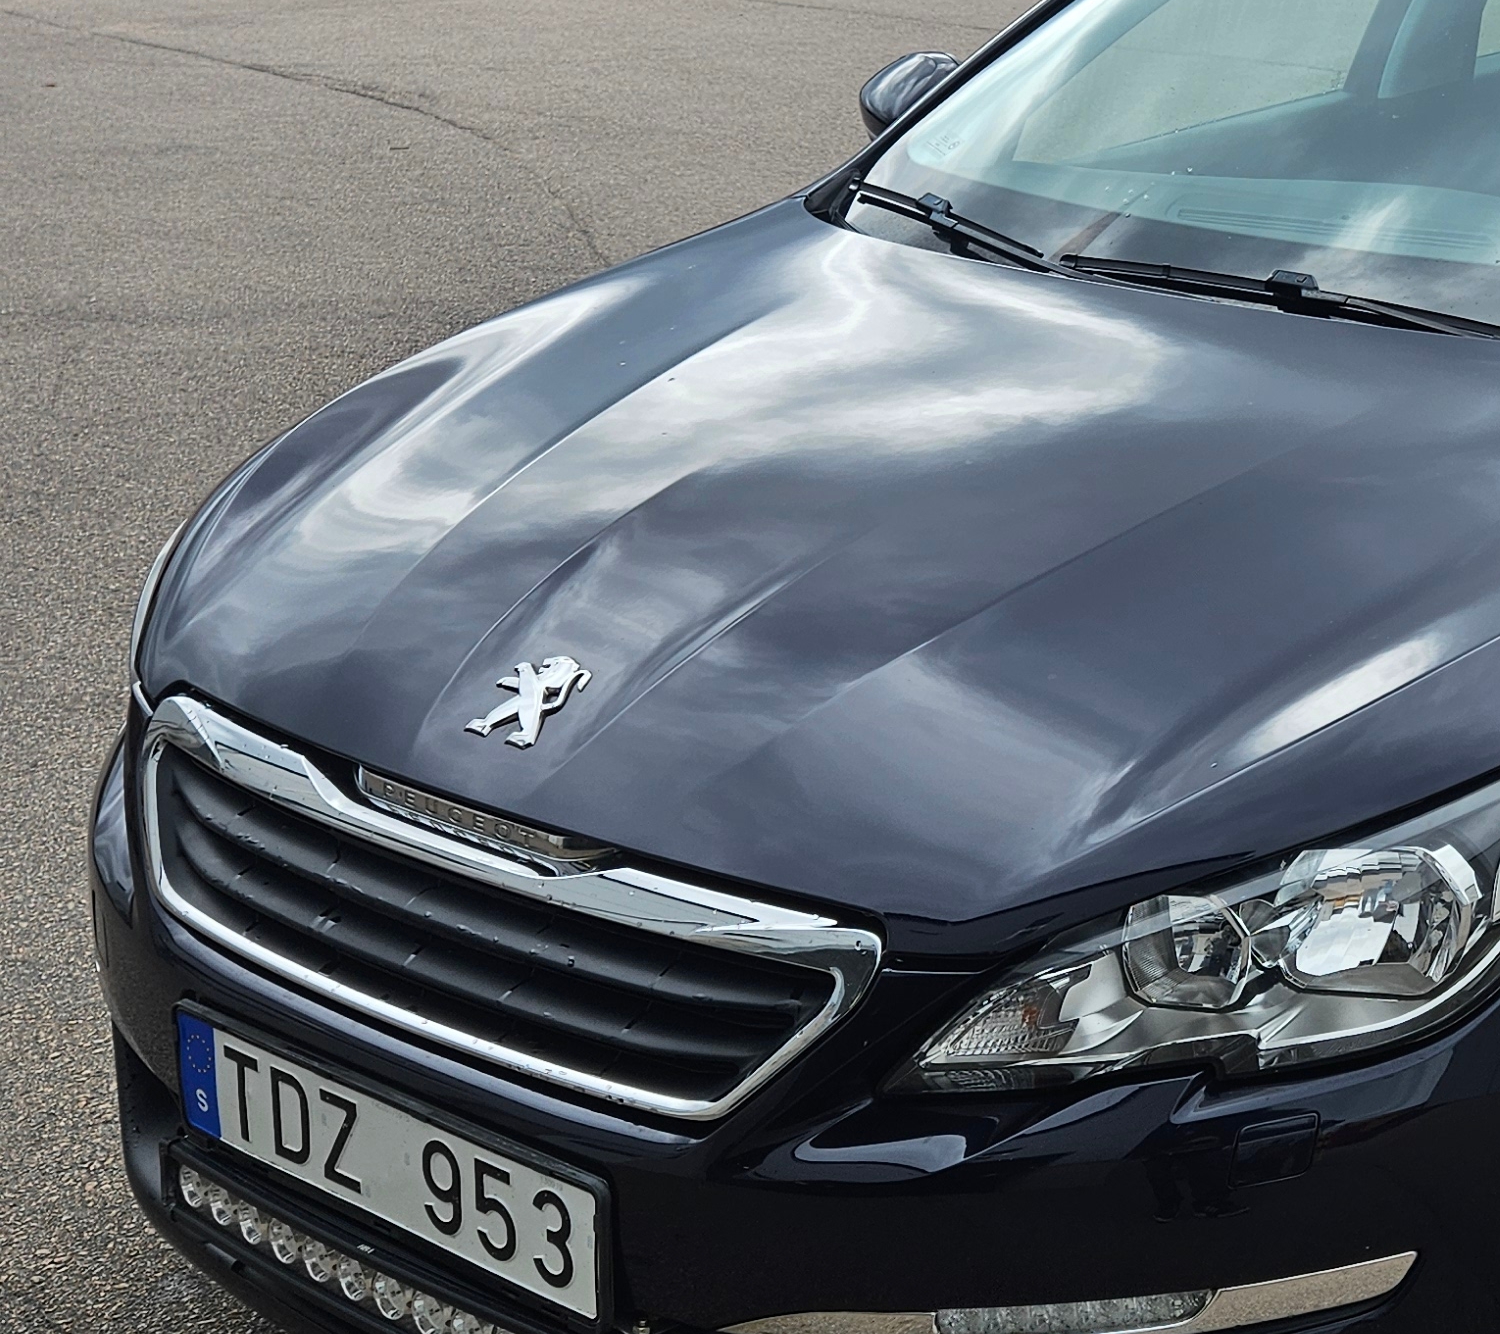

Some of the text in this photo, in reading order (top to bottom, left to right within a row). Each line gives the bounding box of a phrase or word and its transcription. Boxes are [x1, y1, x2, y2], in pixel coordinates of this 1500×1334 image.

[383, 782, 536, 848] PEUGEOT
[195, 1088, 209, 1113] S
[223, 1044, 575, 1289] TDZ 953
